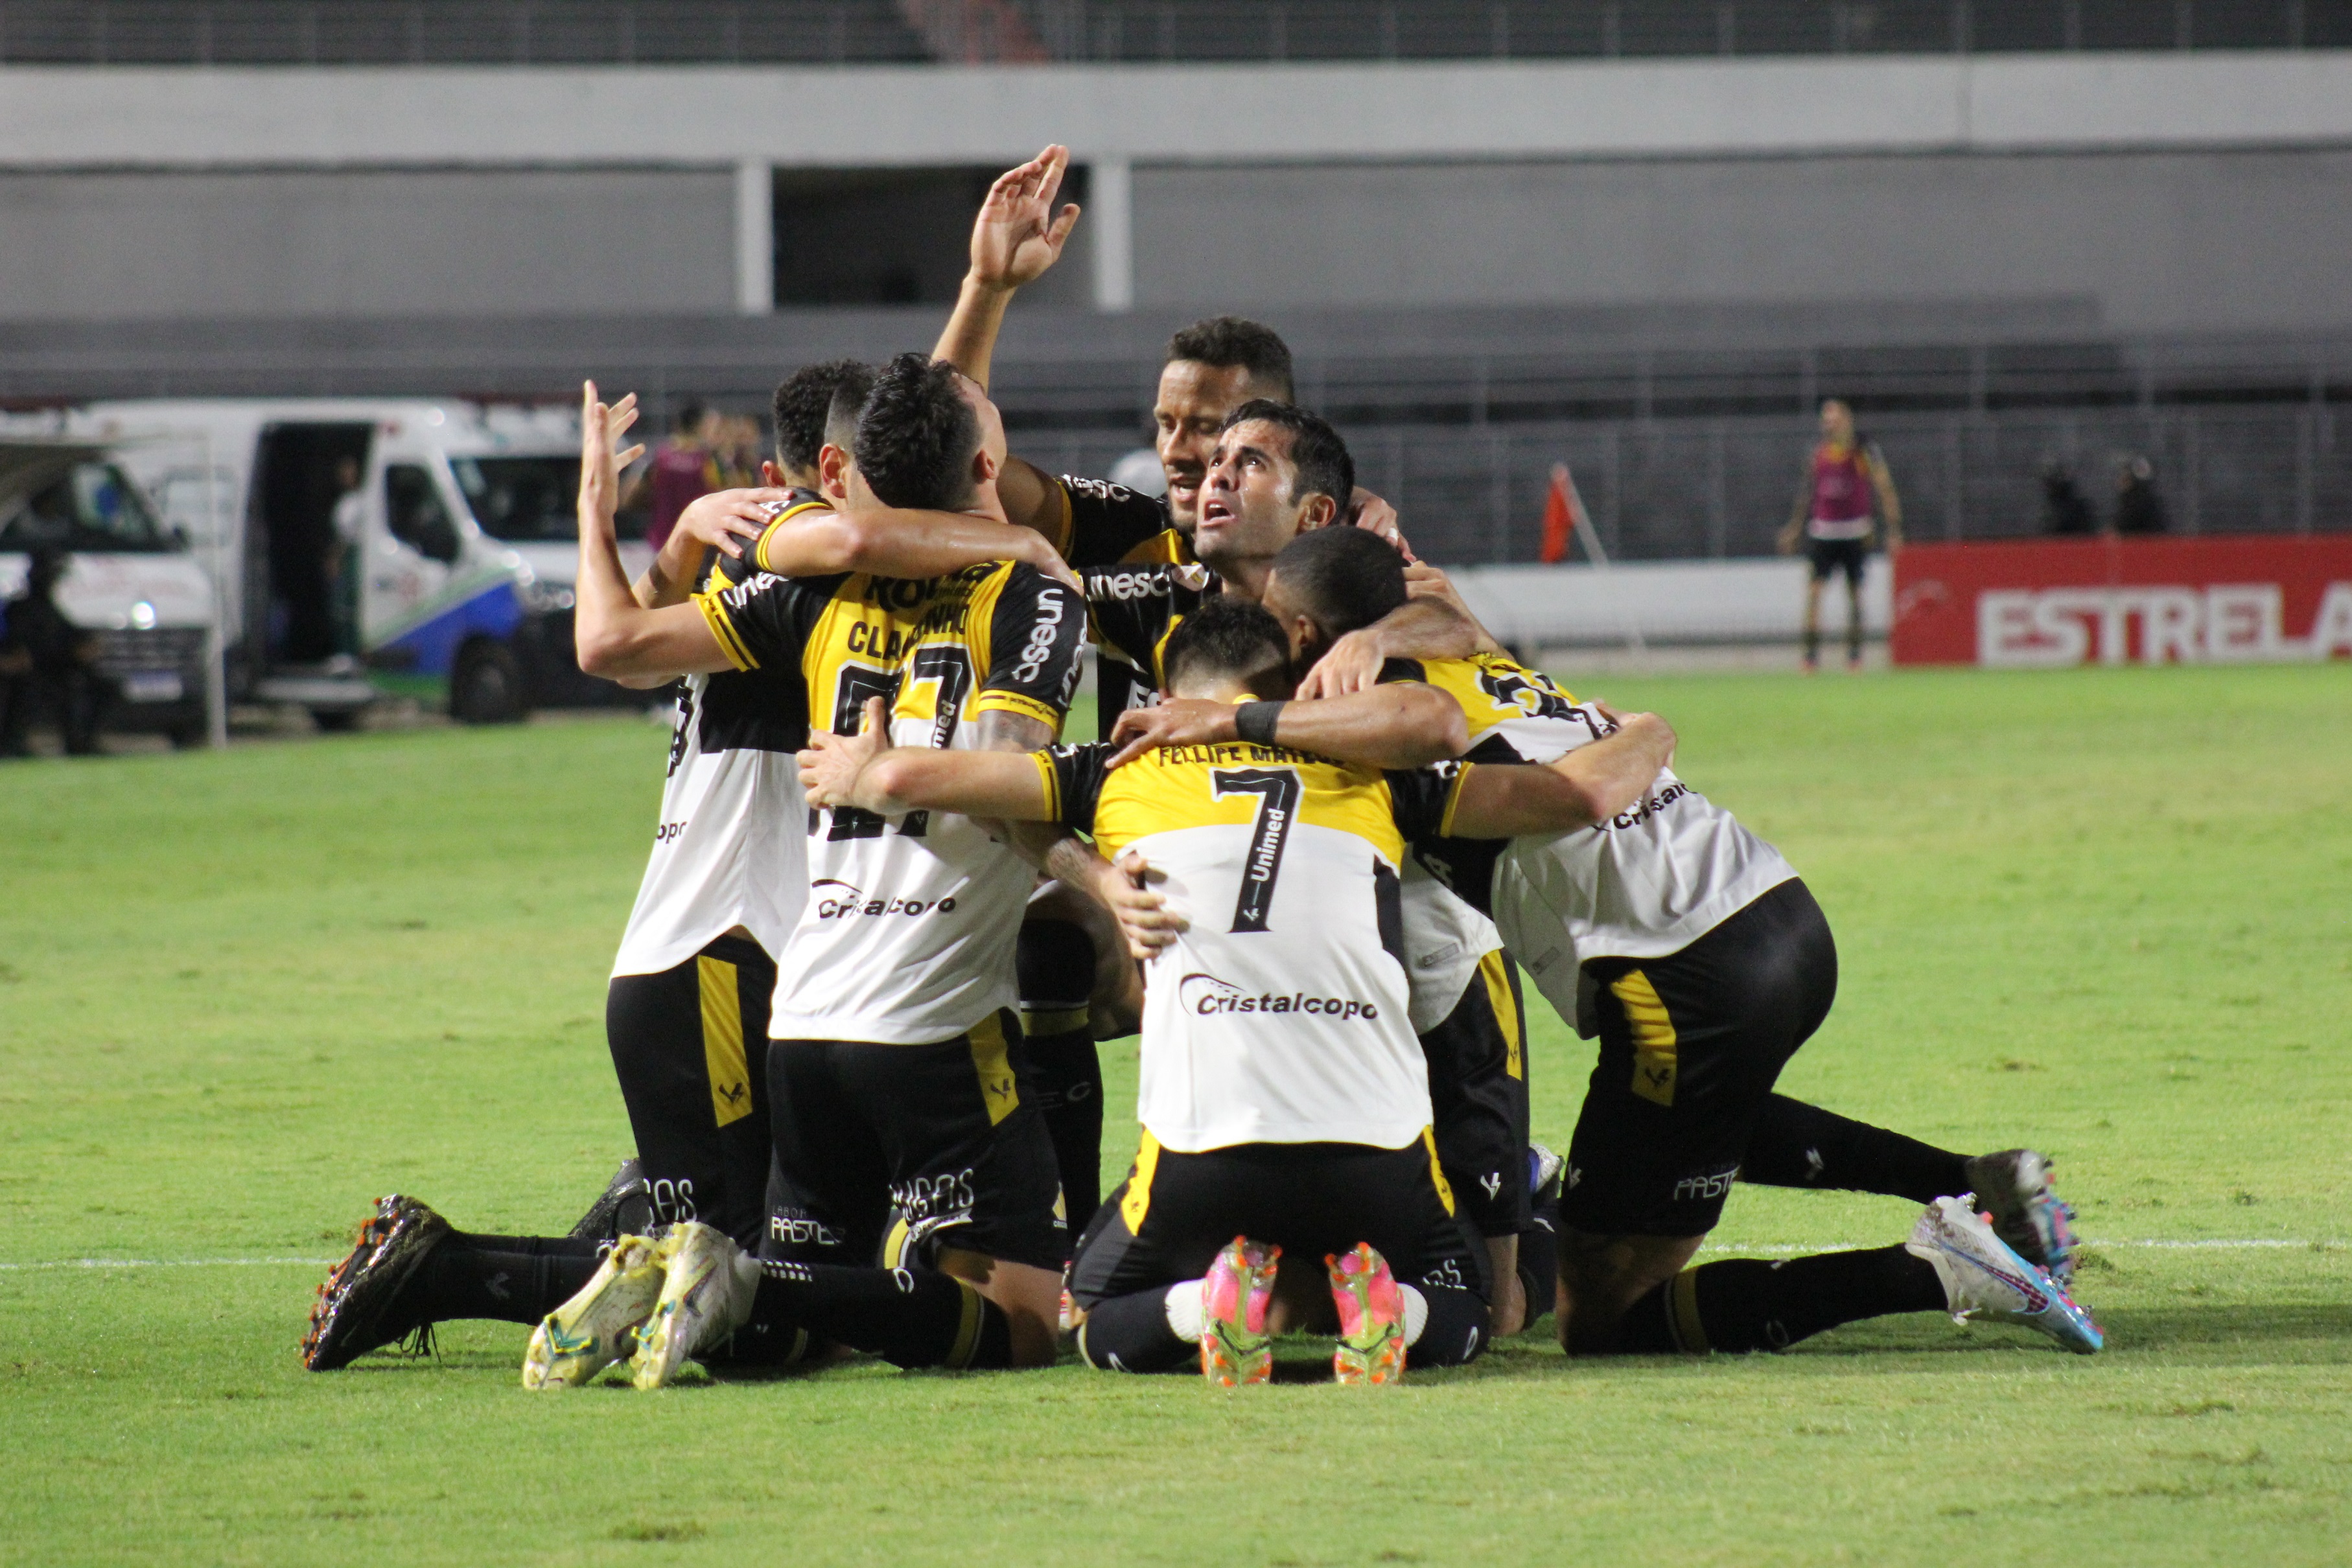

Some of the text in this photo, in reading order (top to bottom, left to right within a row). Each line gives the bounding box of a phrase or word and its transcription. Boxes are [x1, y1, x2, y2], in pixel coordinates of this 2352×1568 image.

[1012, 588, 1064, 683] unesc
[1977, 582, 2352, 666] ESTRELA
[1159, 745, 1243, 767] FELLIPE
[1211, 767, 1304, 933] 7
[1251, 808, 1286, 882] Unimed
[1197, 993, 1378, 1020] Cristalcopo
